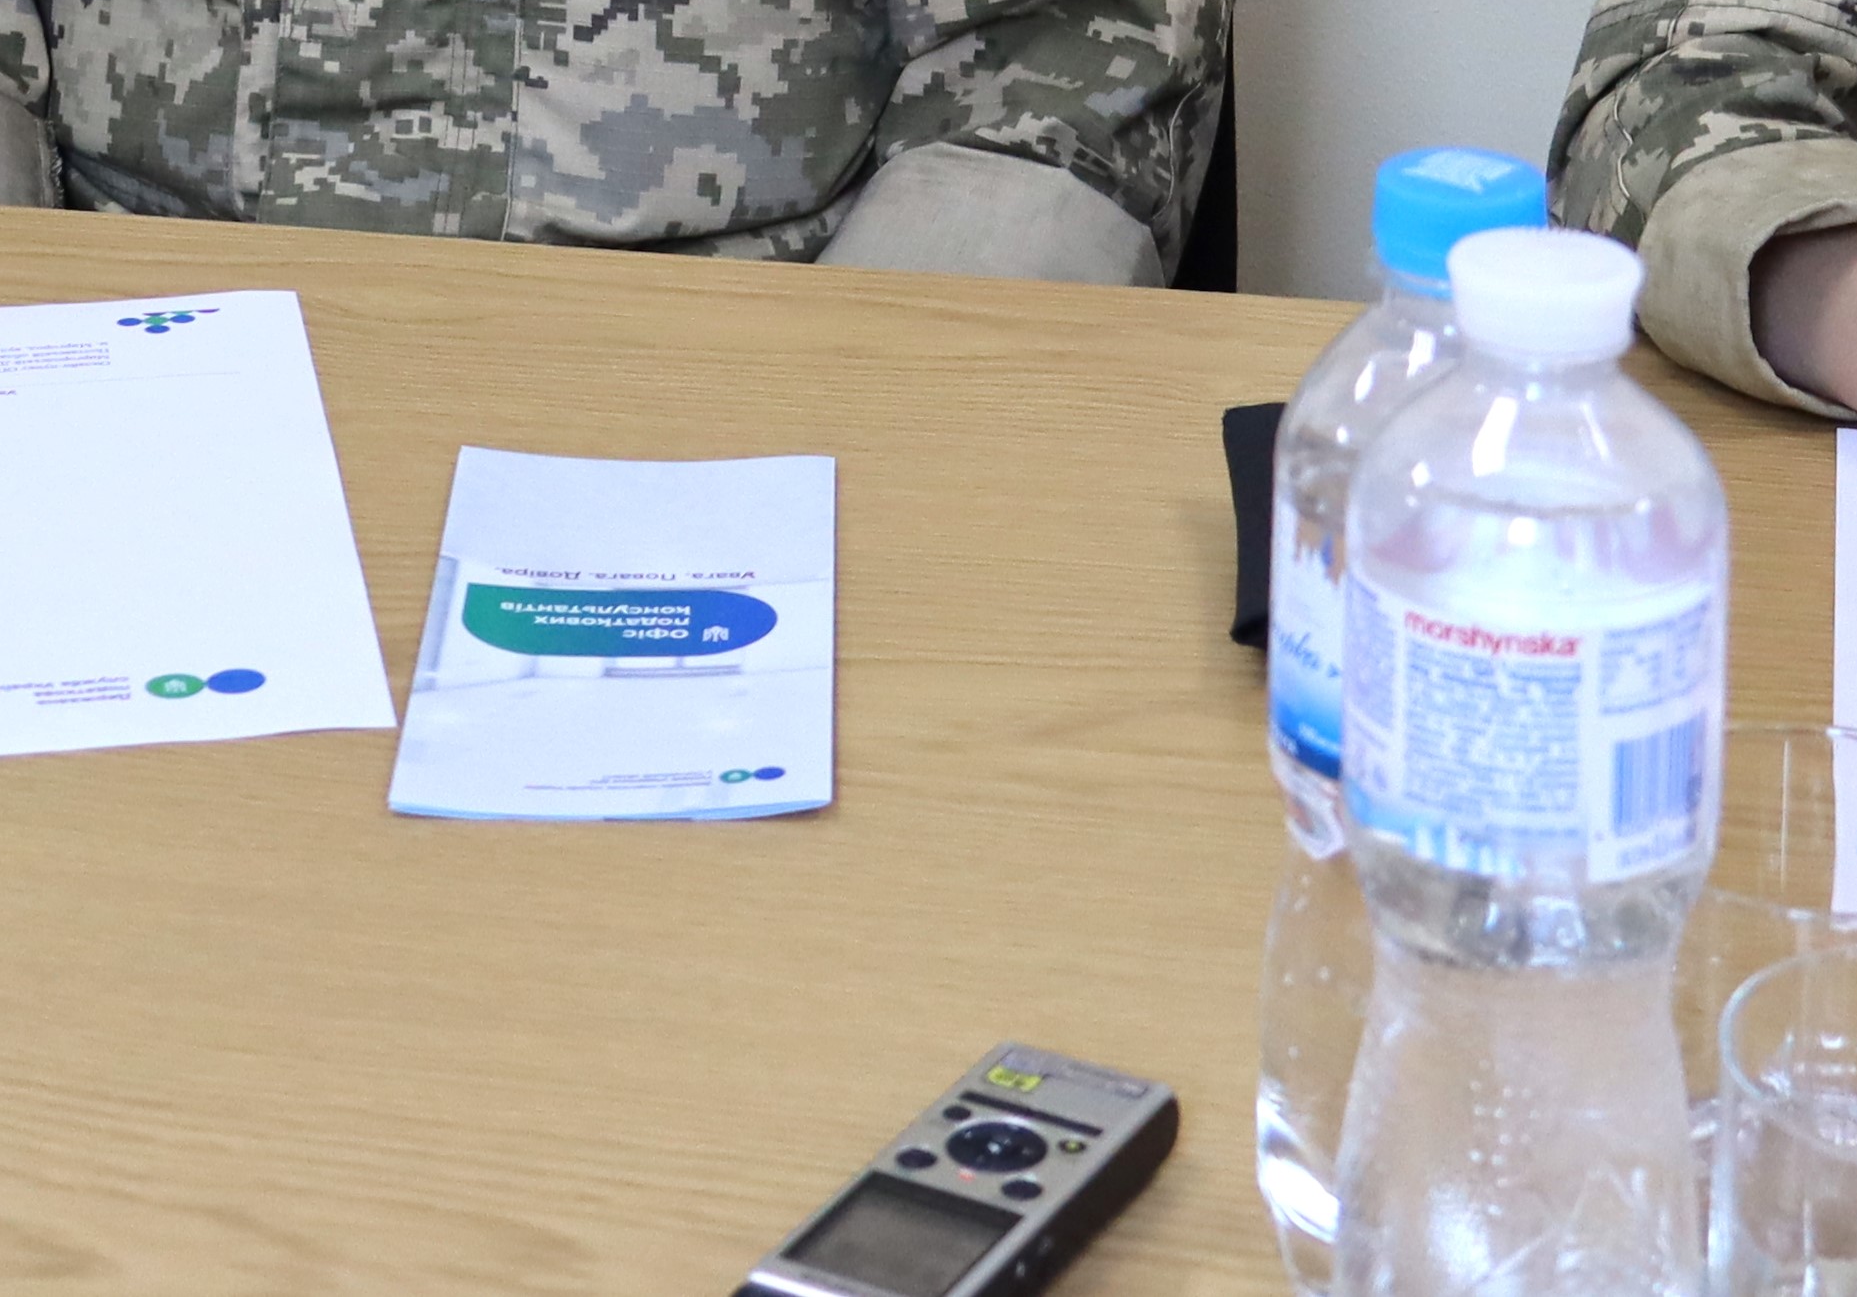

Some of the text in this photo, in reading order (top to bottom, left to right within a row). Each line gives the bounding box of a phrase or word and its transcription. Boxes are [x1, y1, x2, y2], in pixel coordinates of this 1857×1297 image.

[495, 567, 581, 580] Довіра.
[500, 601, 691, 615] консультантів
[534, 616, 690, 627] податкових
[622, 628, 689, 641] Офіс
[1404, 610, 1582, 656] morshynska
